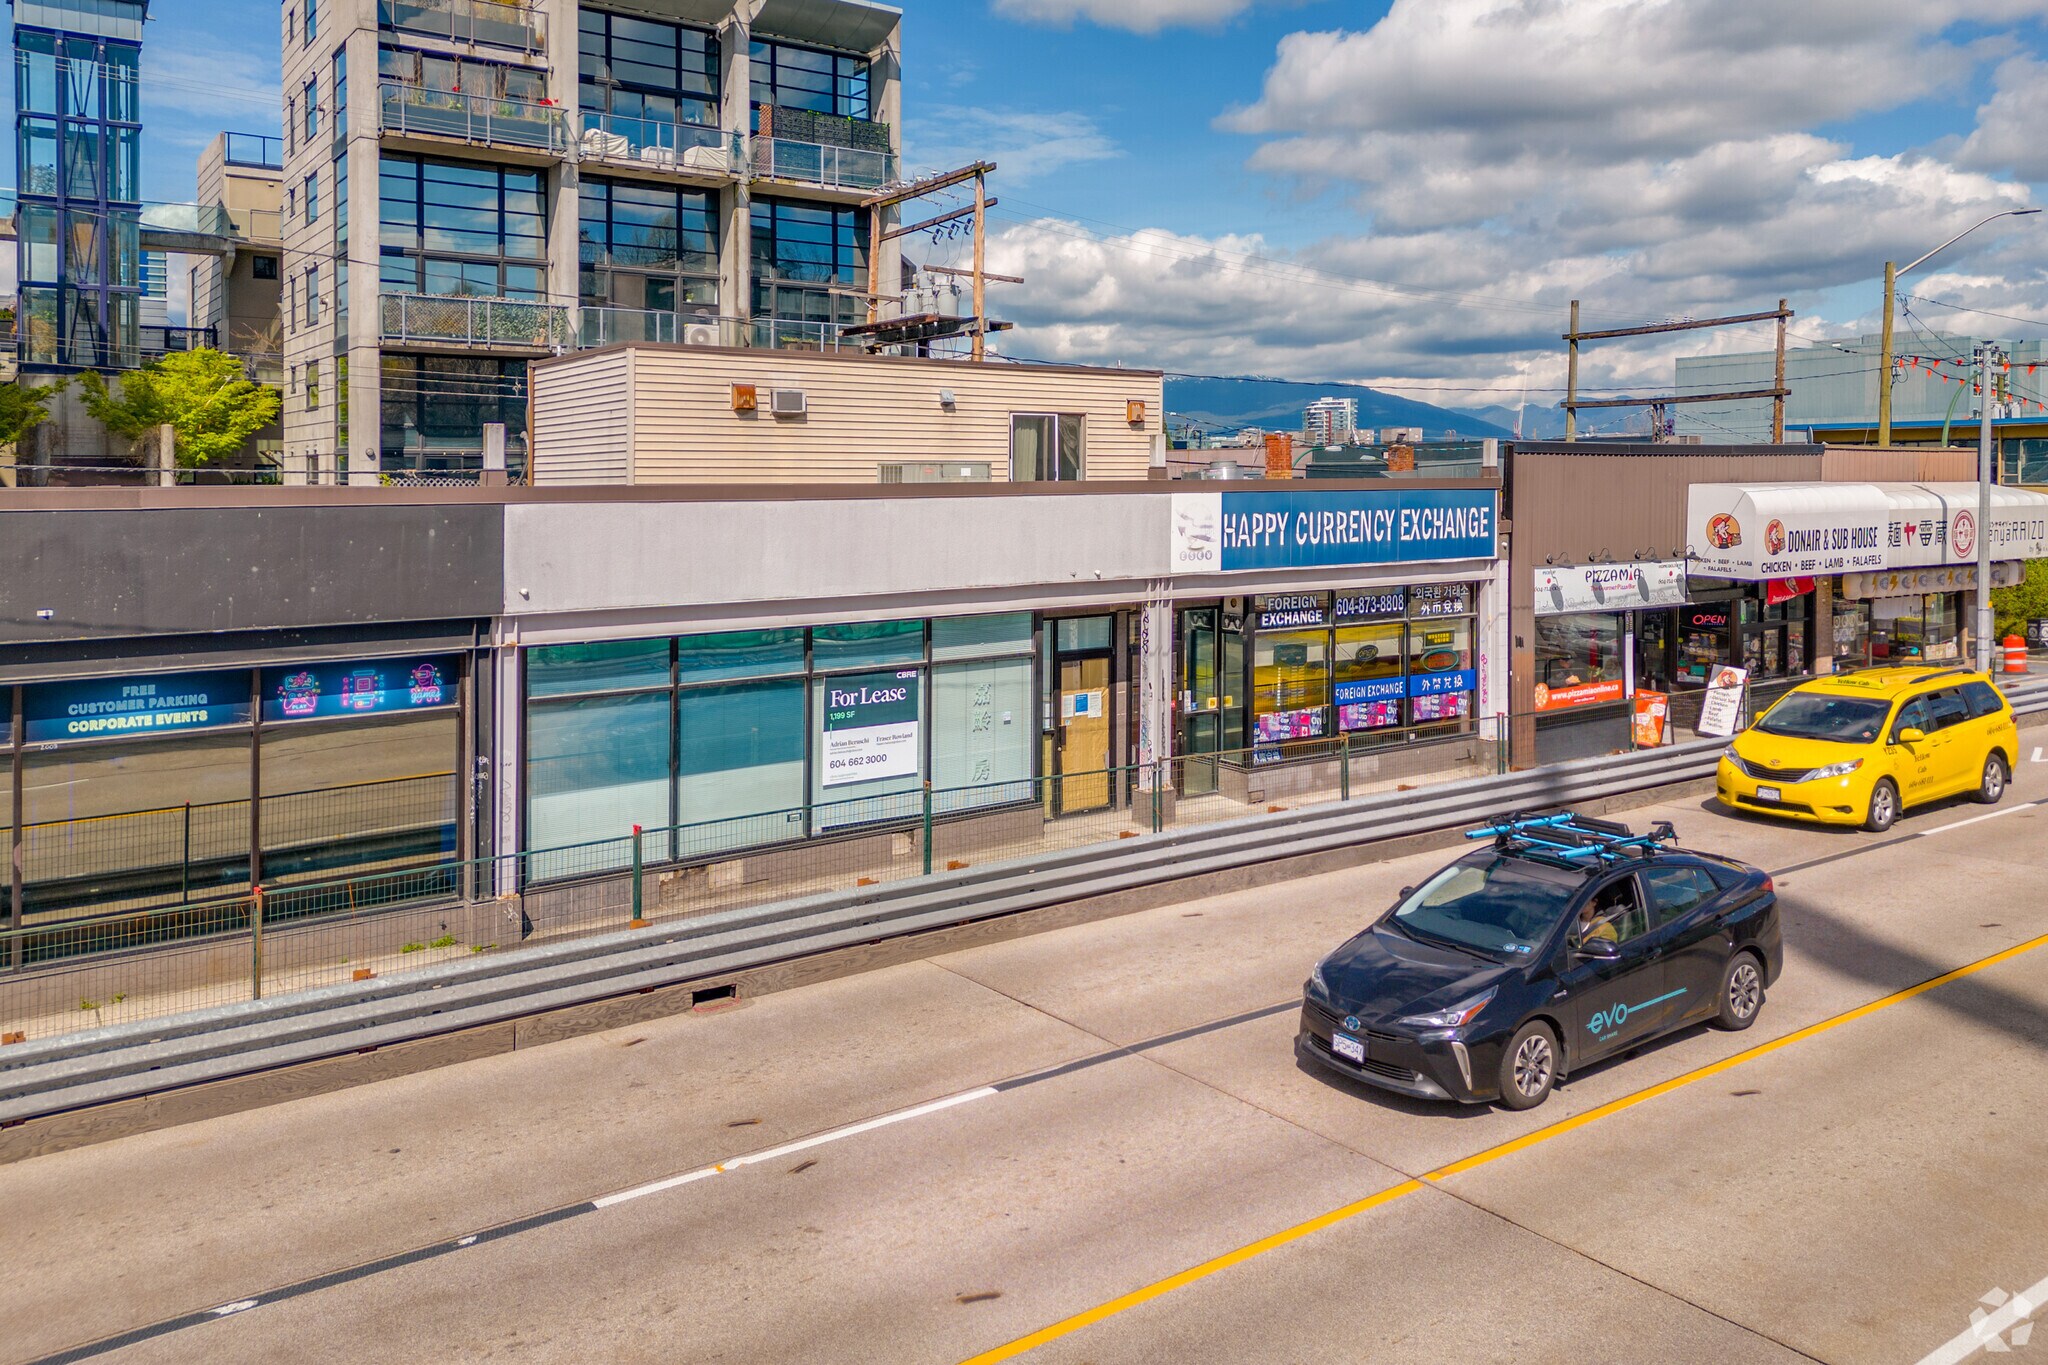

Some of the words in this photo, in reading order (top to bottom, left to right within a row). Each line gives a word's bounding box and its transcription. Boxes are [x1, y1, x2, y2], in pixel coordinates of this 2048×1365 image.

[1223, 511, 1290, 548] HAPPY
[1295, 508, 1396, 546] CURRENCY
[1400, 506, 1490, 541] EXCHANGE
[1788, 529, 1821, 553] DONAIR
[1823, 529, 1830, 550] &
[1832, 527, 1849, 549] SUB
[1851, 526, 1878, 548] HOUSE
[1761, 560, 1792, 574] CHICKEN
[1801, 559, 1816, 570] BEEF
[1824, 557, 1844, 569] LAMB
[1852, 554, 1882, 567] FALAFELS
[1415, 586, 1441, 599] 외국환
[1443, 584, 1469, 598] 거래소
[1267, 595, 1318, 611] FOREIGN
[1336, 594, 1404, 616] 604-873-8808
[1261, 609, 1323, 627] EXCHANGE
[1693, 614, 1726, 624] OPEN
[896, 671, 917, 679] CBRE
[122, 685, 156, 698] FREE
[830, 690, 859, 708] For
[860, 687, 907, 705] Lease
[1367, 681, 1404, 698] EXCHANGE
[1551, 683, 1619, 700] www.pizzamiaonline.ca
[68, 700, 145, 716] CUSTOMER
[149, 694, 208, 709] PARKING
[68, 715, 153, 733] CORPORATE
[156, 710, 208, 726] EVENTS
[830, 711, 845, 721] 1,199
[846, 711, 855, 719] SF
[830, 740, 848, 748] Adrian
[829, 759, 846, 769] 604
[848, 756, 864, 767] 662
[865, 753, 888, 765] 3000
[1586, 1002, 1628, 1034] evo
